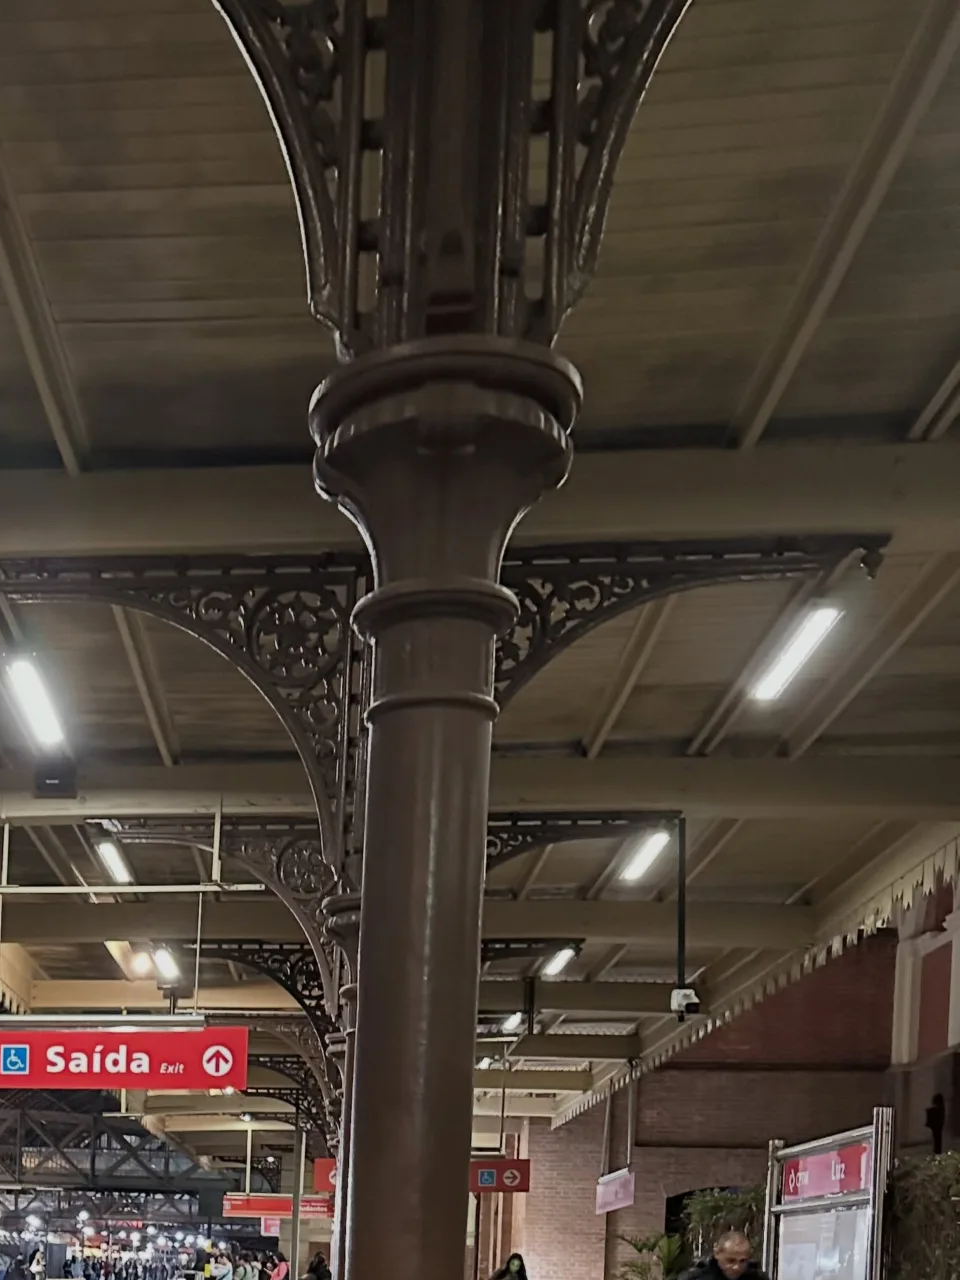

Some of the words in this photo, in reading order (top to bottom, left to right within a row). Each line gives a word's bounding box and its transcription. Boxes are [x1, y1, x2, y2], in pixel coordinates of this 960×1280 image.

[45, 1044, 150, 1073] Saída
[159, 1062, 185, 1074] Exit
[831, 1159, 845, 1181] Luz
